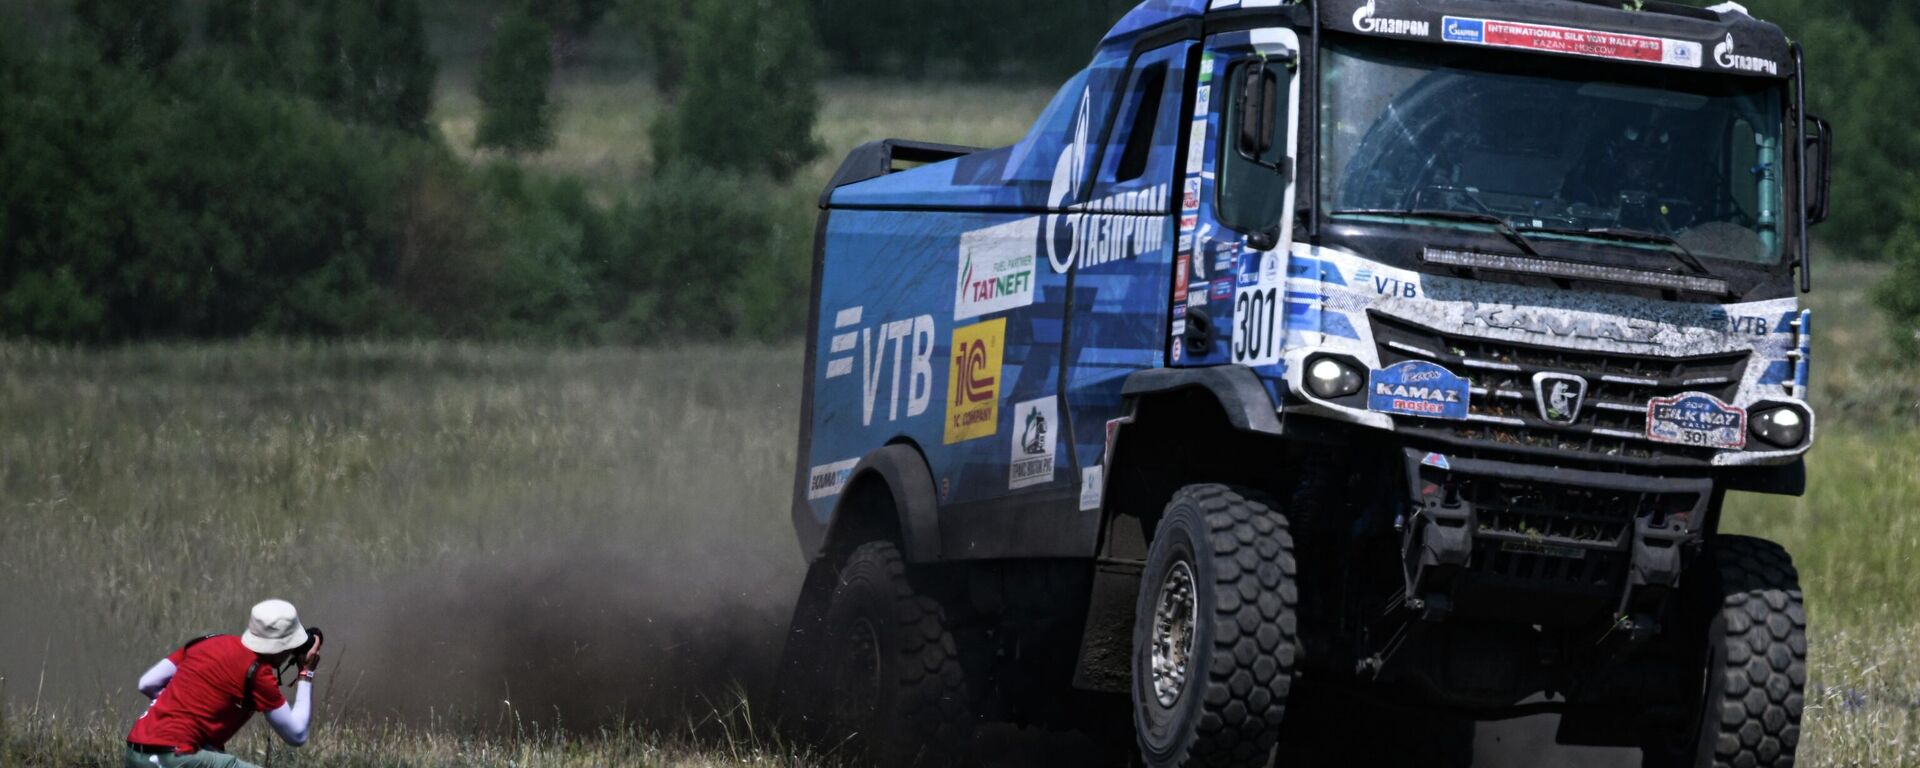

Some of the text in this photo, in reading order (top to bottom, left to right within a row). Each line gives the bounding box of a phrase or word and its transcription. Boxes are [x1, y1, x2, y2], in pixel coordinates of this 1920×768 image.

[1374, 18, 1430, 36] ГАЗПРОМ
[1487, 24, 1562, 39] INTERNATIONAL
[1564, 32, 1584, 42] SILK
[1586, 34, 1607, 44] WAY
[1609, 37, 1639, 47] RALLY
[1532, 39, 1566, 49] KAZAN
[1574, 43, 1617, 55] MOSCOW
[1733, 54, 1777, 75] ГАЗПРОМ
[1077, 183, 1168, 270] ГАЗПРОМ
[972, 270, 1032, 303] TATNEFT
[1374, 276, 1417, 298] VTB
[1234, 287, 1277, 362] 301
[1729, 316, 1768, 336] VTB
[862, 314, 936, 427] VTB
[1400, 364, 1442, 383] Team
[1376, 382, 1459, 403] KAMAZ
[1393, 398, 1445, 413] master
[962, 406, 994, 426] COMPANY
[1658, 407, 1736, 425] SILK WAY
[1683, 430, 1707, 444] 301
